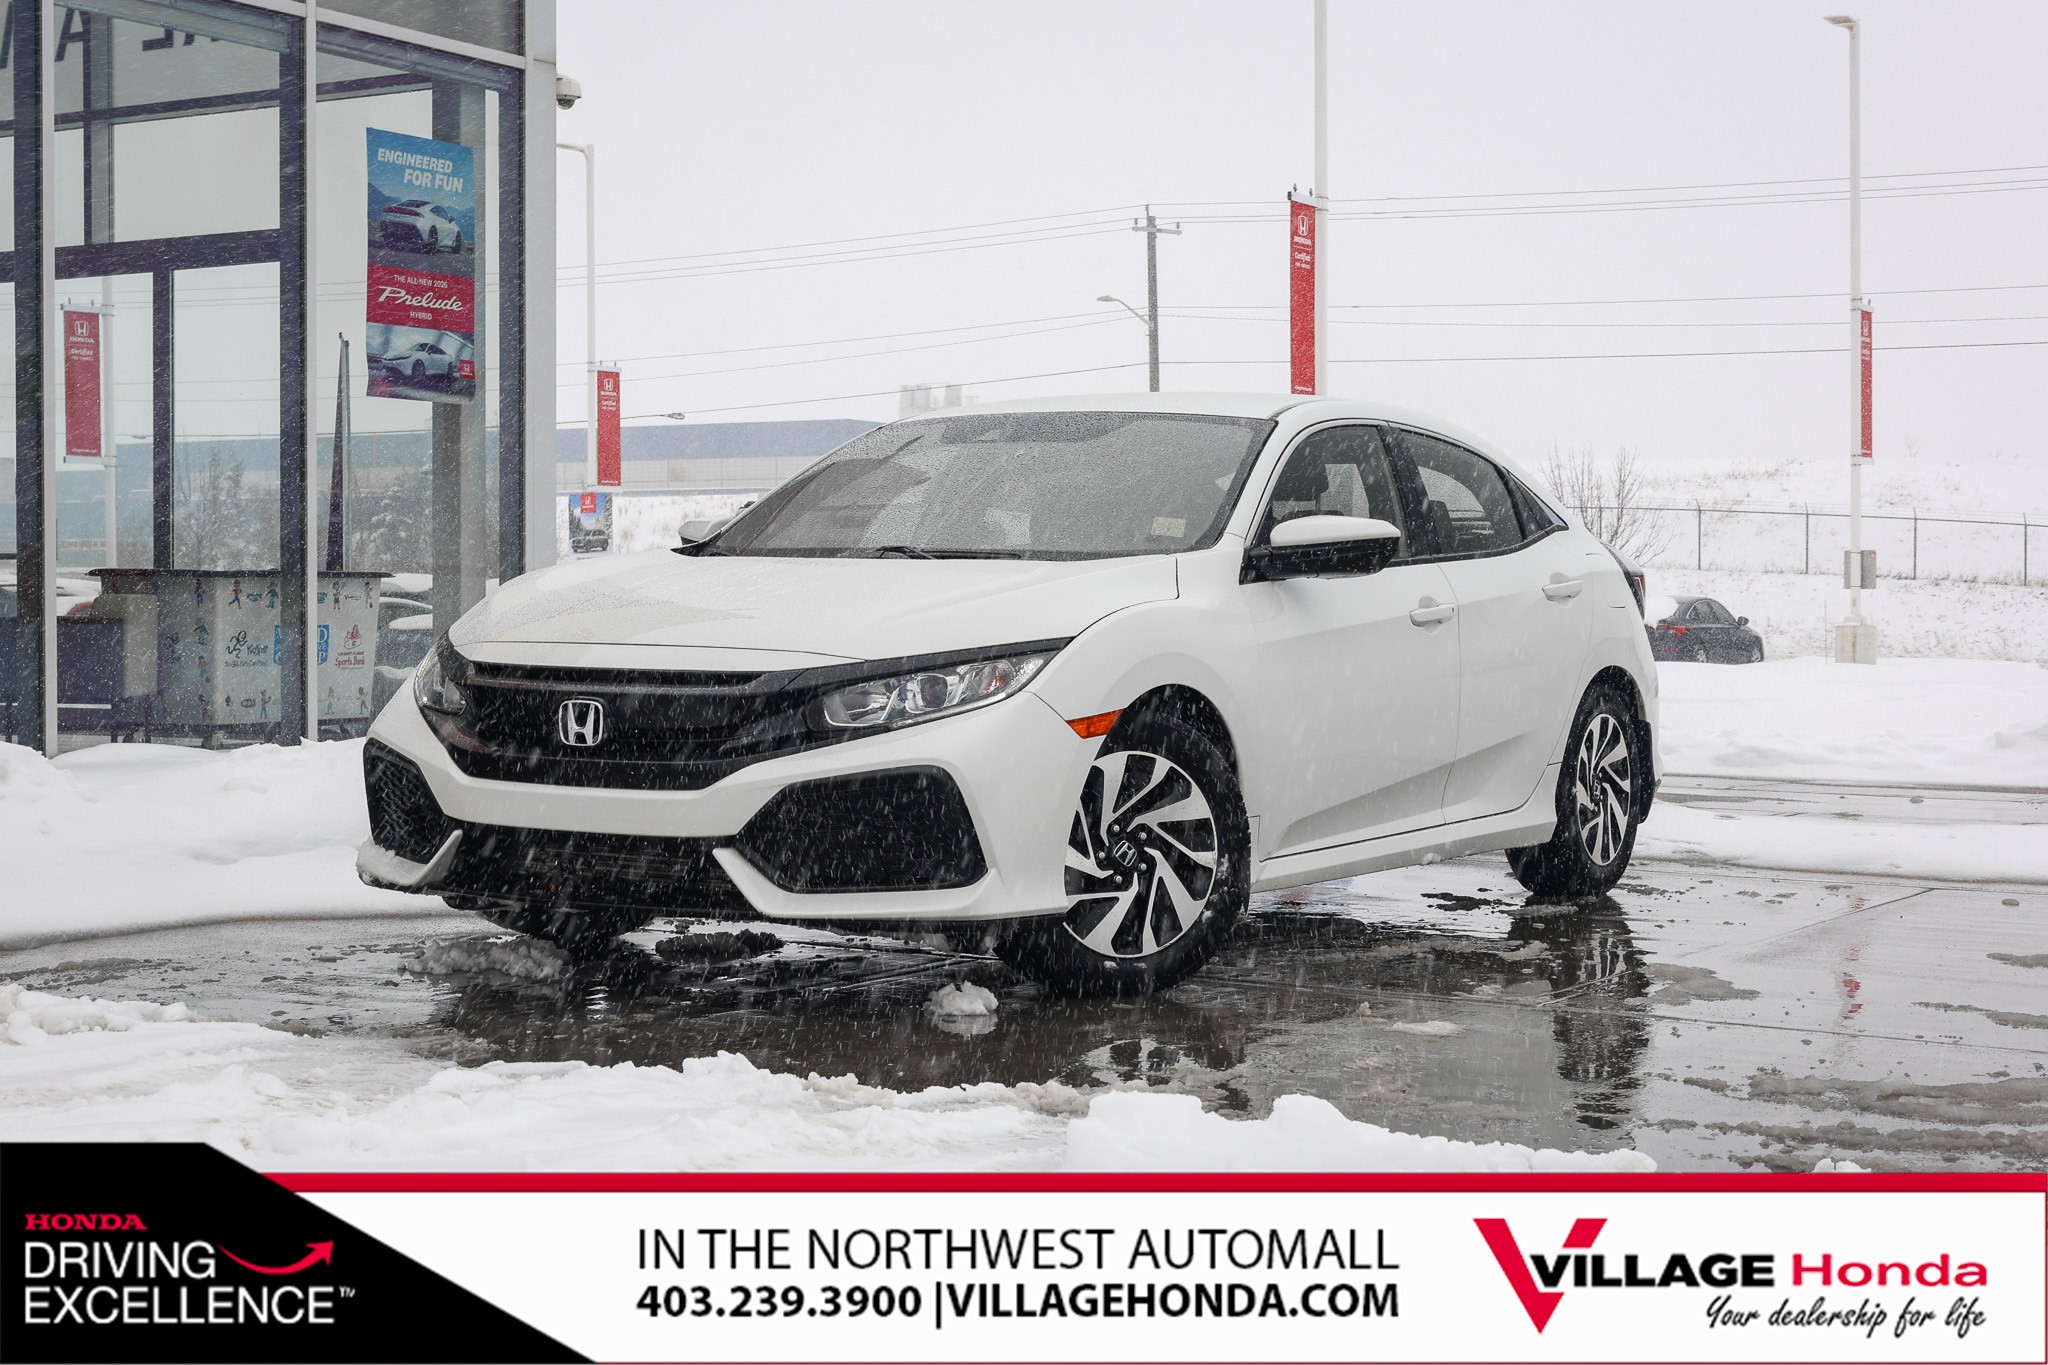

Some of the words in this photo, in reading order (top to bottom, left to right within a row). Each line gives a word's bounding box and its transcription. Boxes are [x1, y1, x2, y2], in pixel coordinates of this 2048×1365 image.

[377, 147, 454, 174] ENGINEERED
[403, 168, 433, 188] FOR
[434, 174, 464, 193] FUN
[394, 274, 406, 283] THE
[407, 276, 433, 287] ALL-NEW
[377, 285, 464, 311] Prelude
[410, 311, 433, 320] HYBRID
